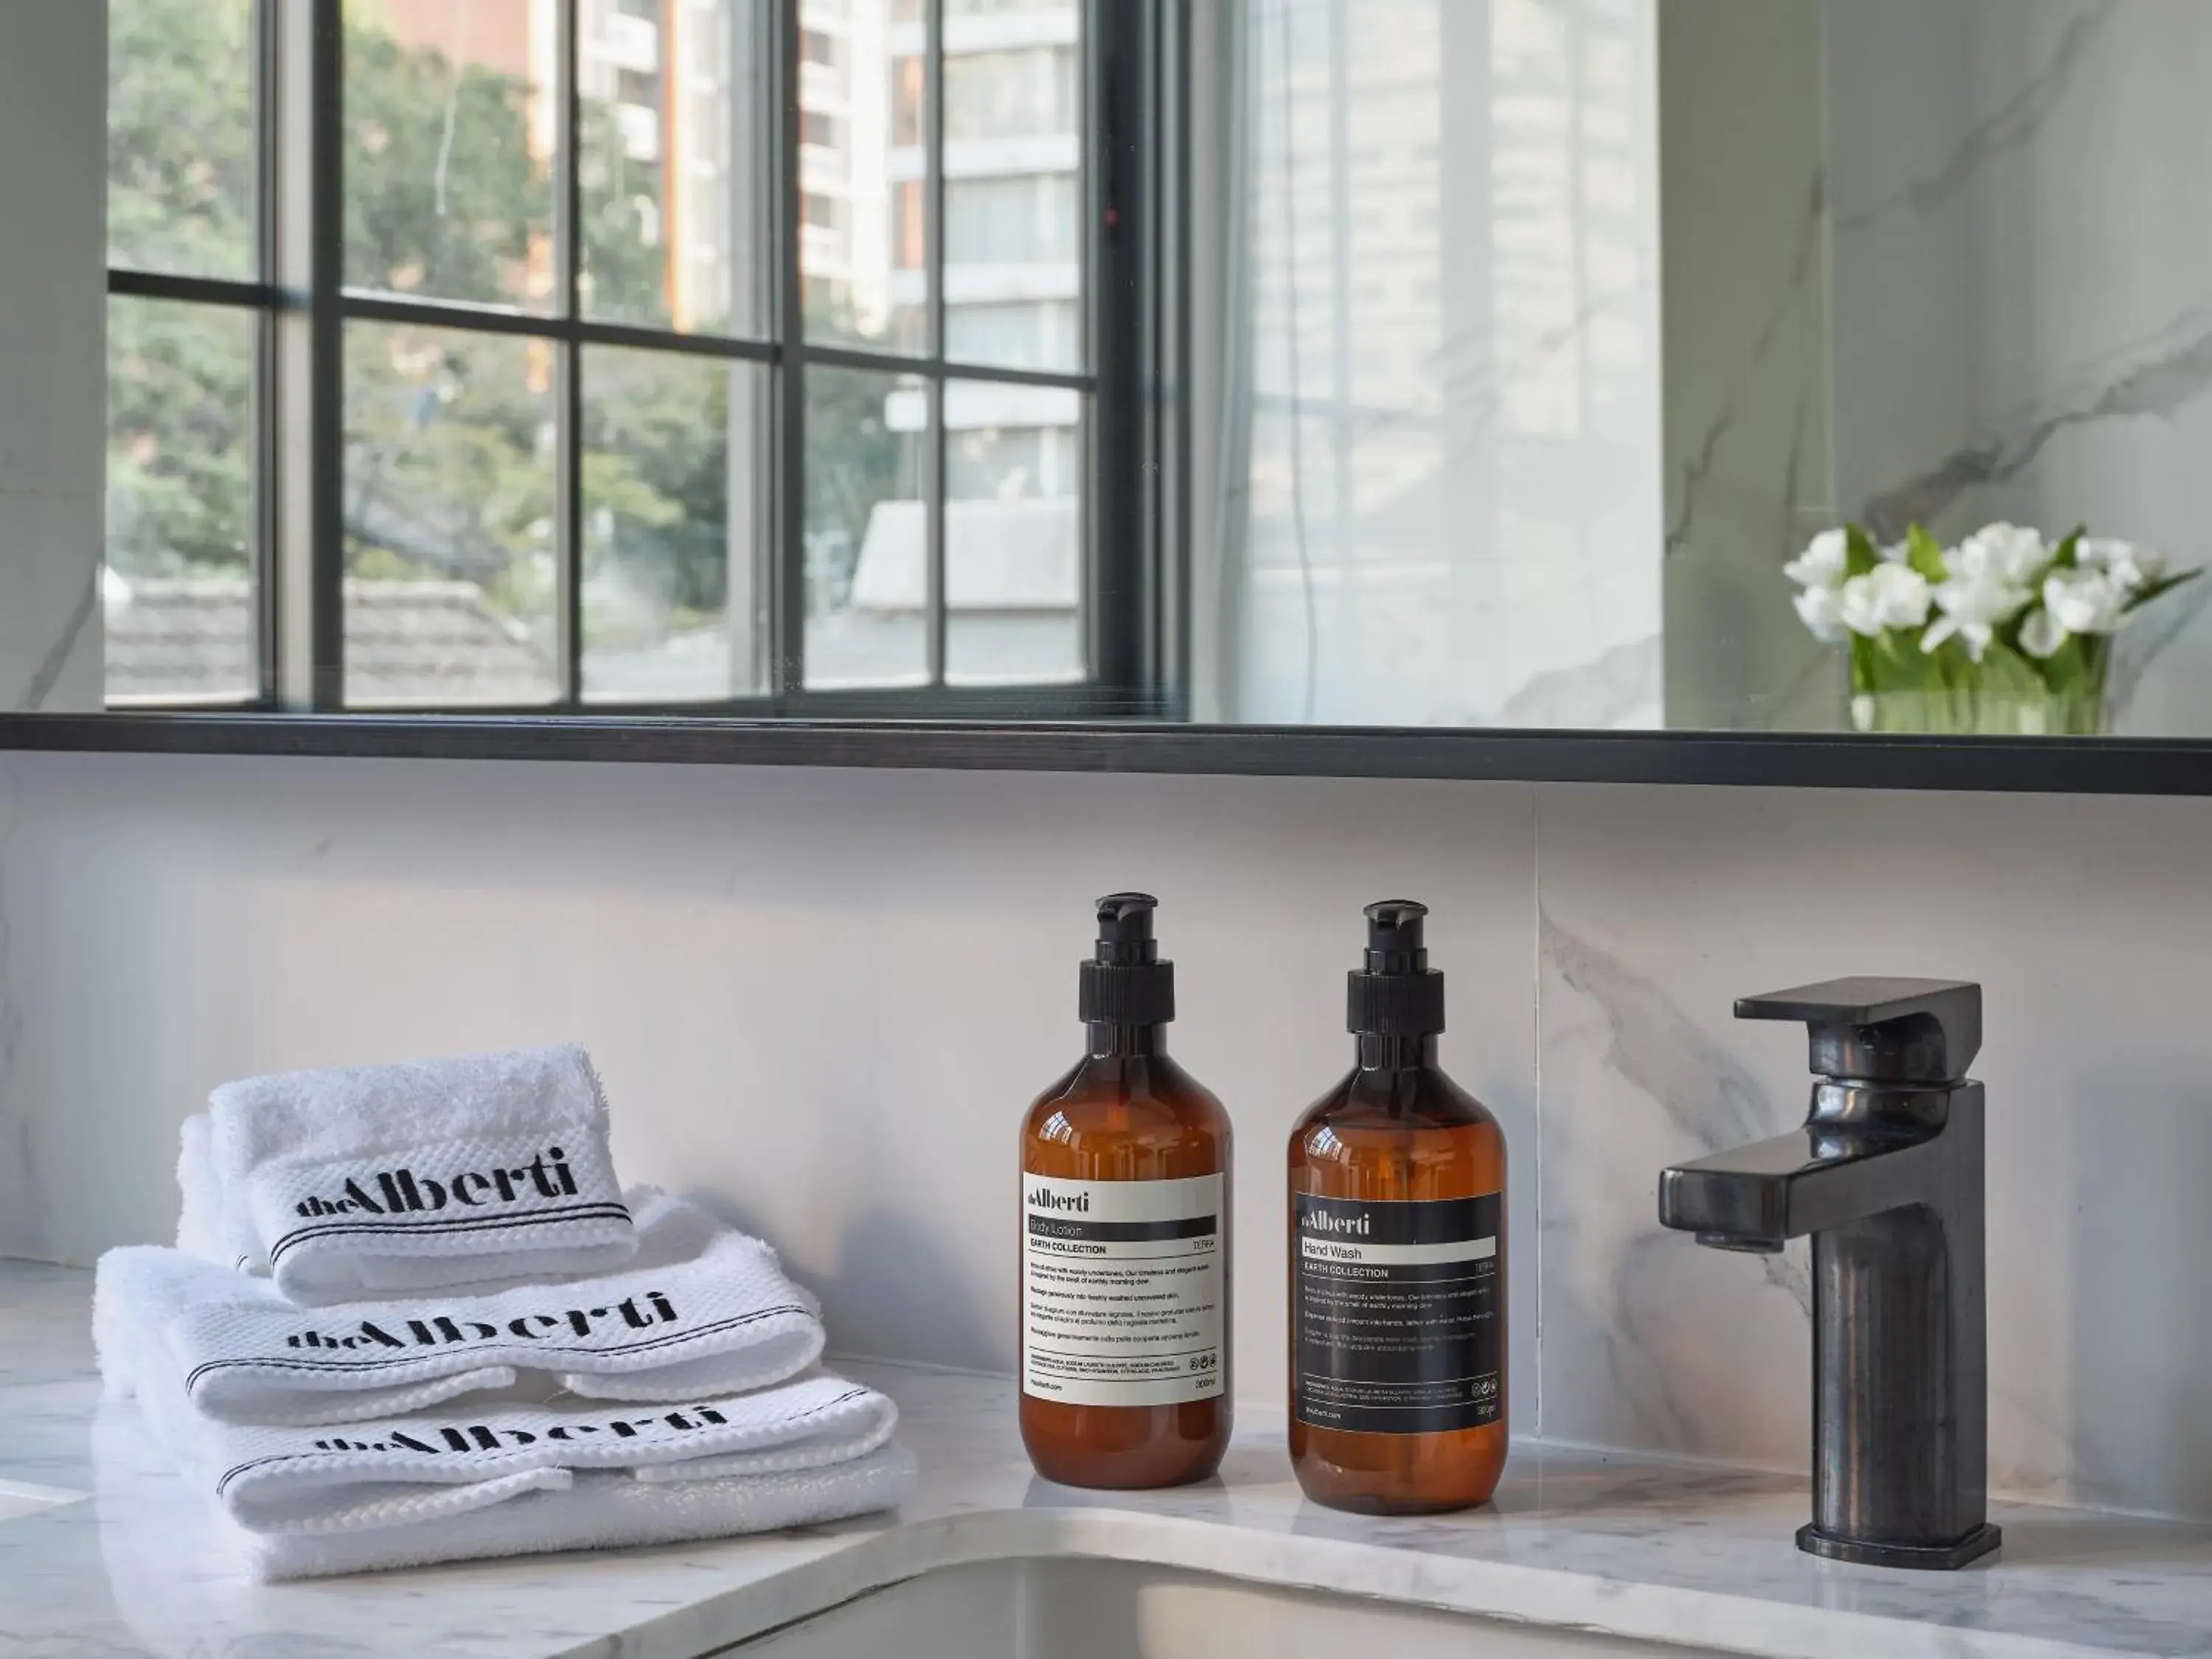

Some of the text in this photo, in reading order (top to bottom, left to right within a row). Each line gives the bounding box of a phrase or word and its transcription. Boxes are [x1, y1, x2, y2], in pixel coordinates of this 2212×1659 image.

[1051, 1223, 1082, 1237] Lotion
[1030, 1239, 1107, 1254] EARTH COLLECTION
[1304, 1240, 1363, 1259] Hand Wash
[1304, 1262, 1388, 1279] EARTH COLLECTION
